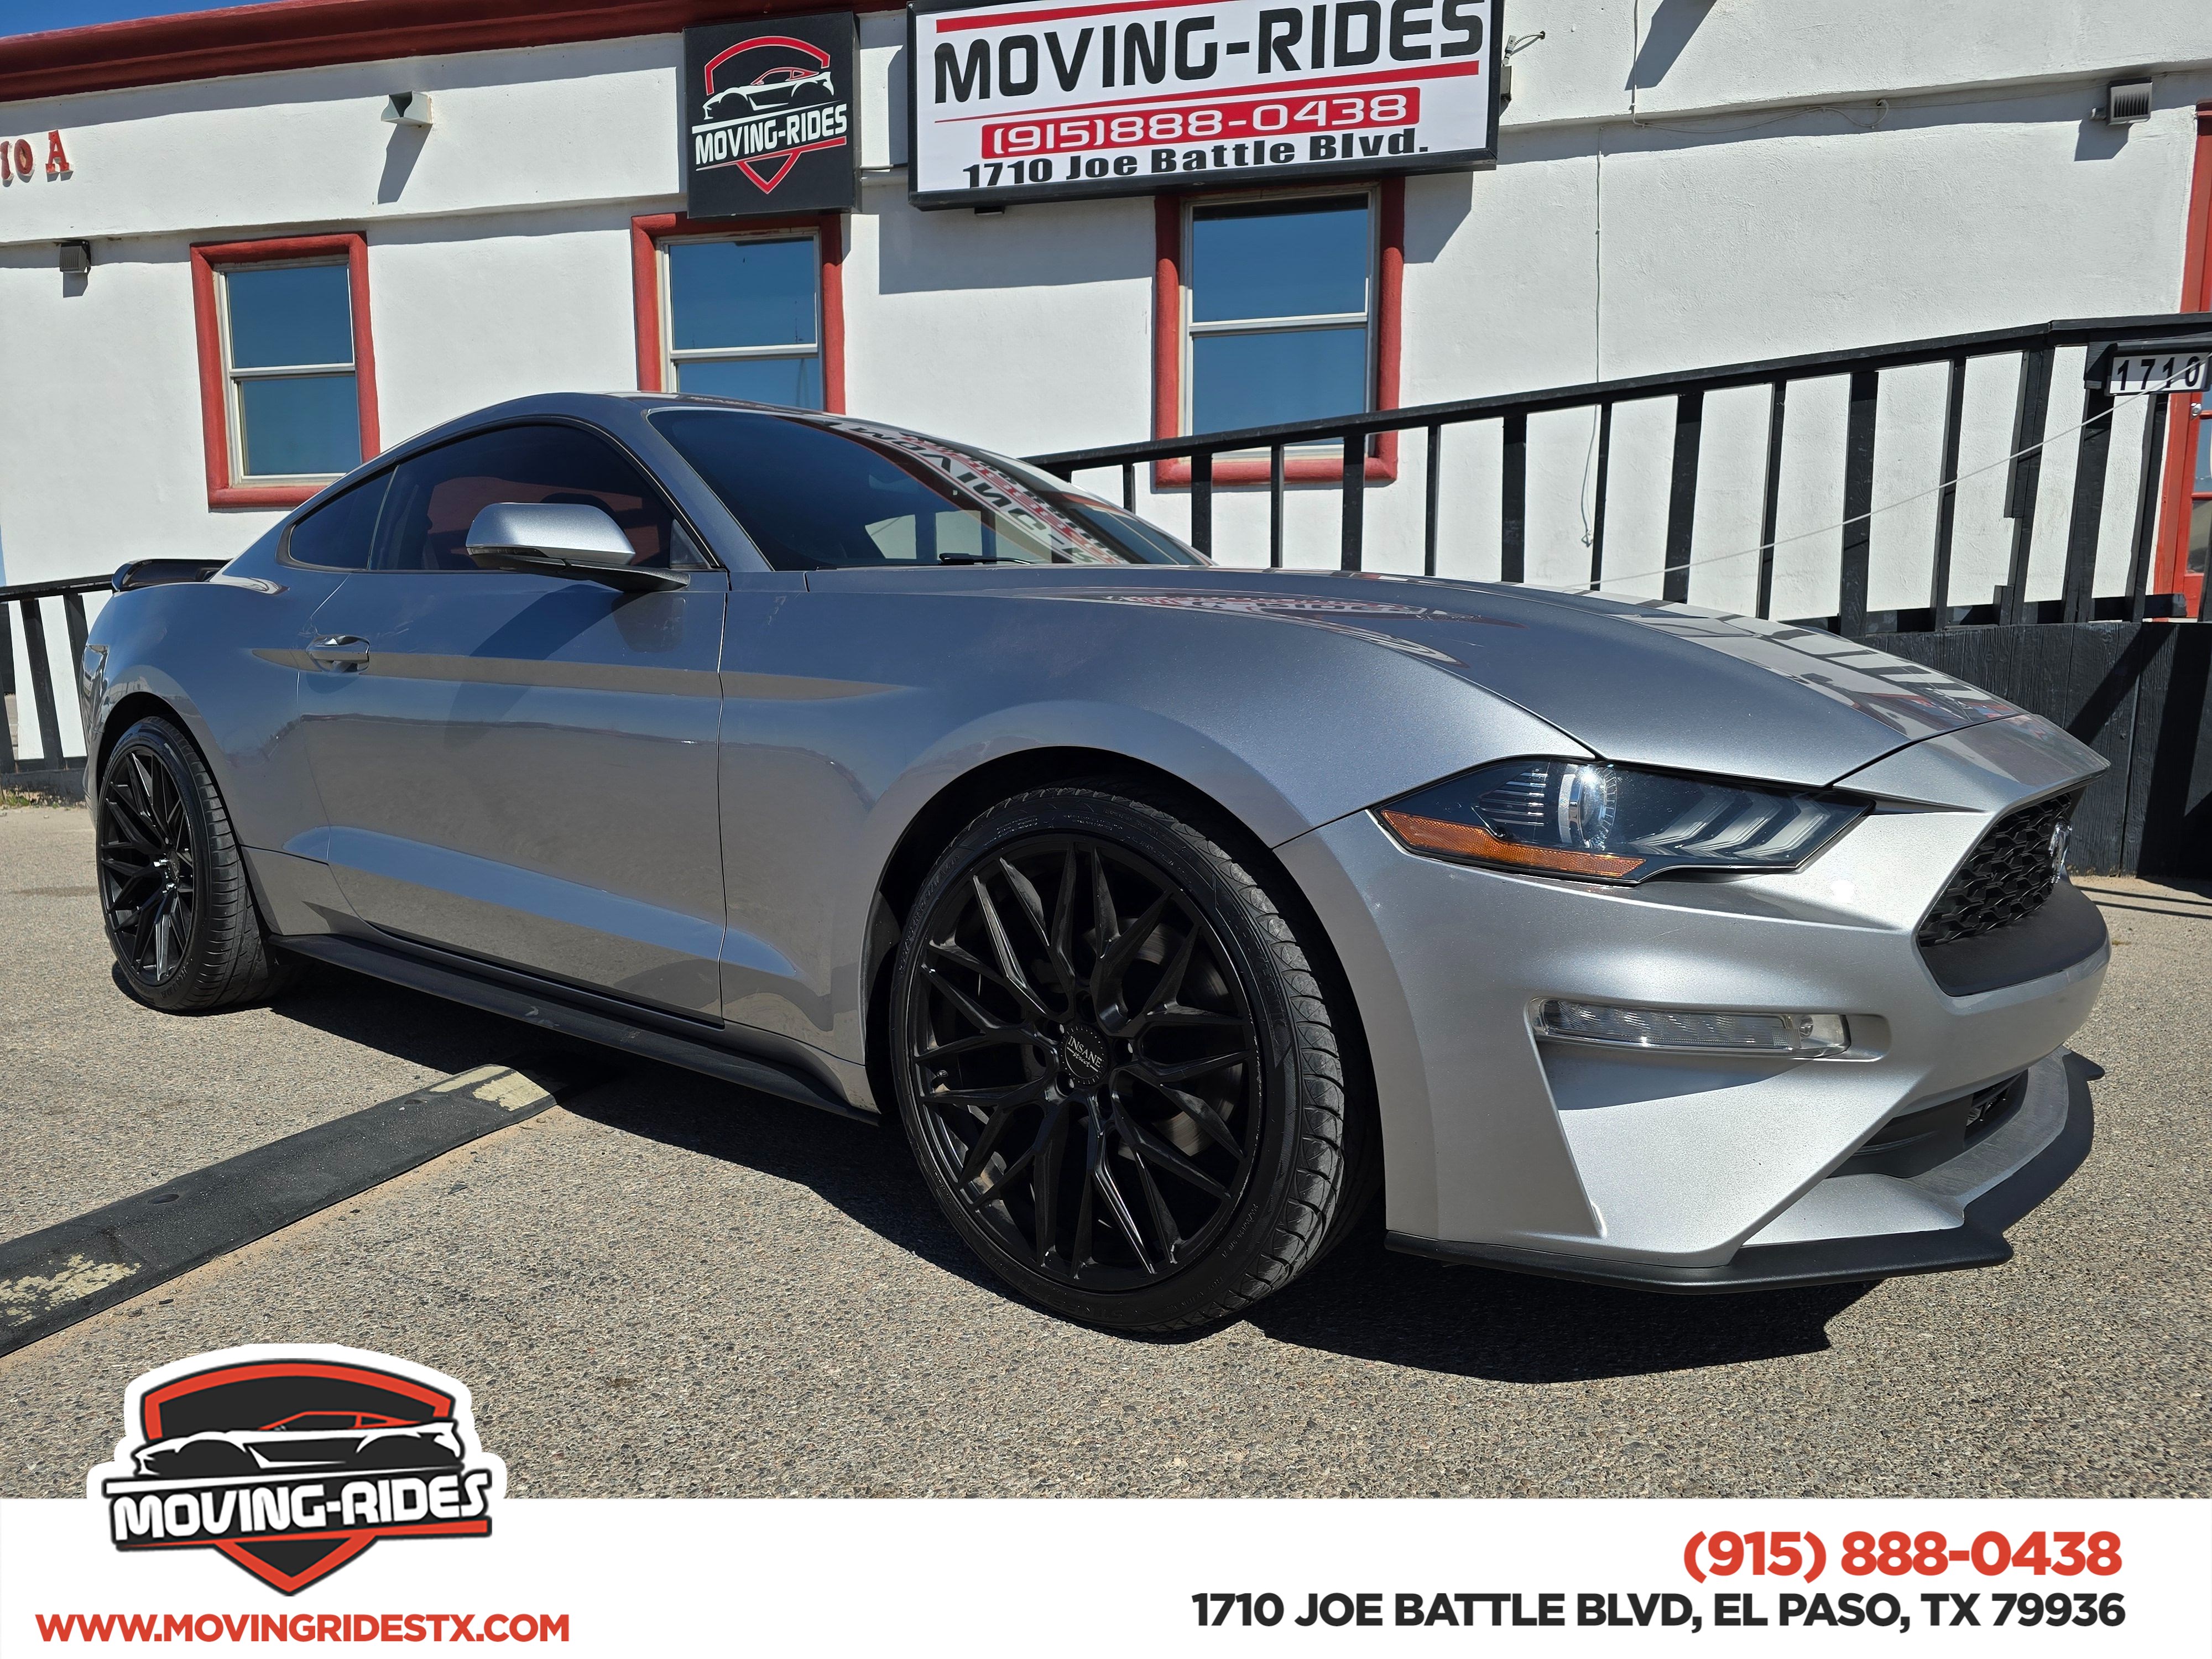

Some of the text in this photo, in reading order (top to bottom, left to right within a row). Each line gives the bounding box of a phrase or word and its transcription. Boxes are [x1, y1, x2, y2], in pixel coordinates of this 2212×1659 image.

[935, 0, 1483, 104] MOVING-RIDES
[45, 129, 70, 173] A
[695, 103, 847, 165] MOVING-RIDES
[994, 94, 1407, 154] (915)888-0438
[963, 127, 1428, 189] 1710 Joe Battle Blvd.
[2117, 356, 2200, 390] 1710
[1068, 1035, 1102, 1068] INSANE
